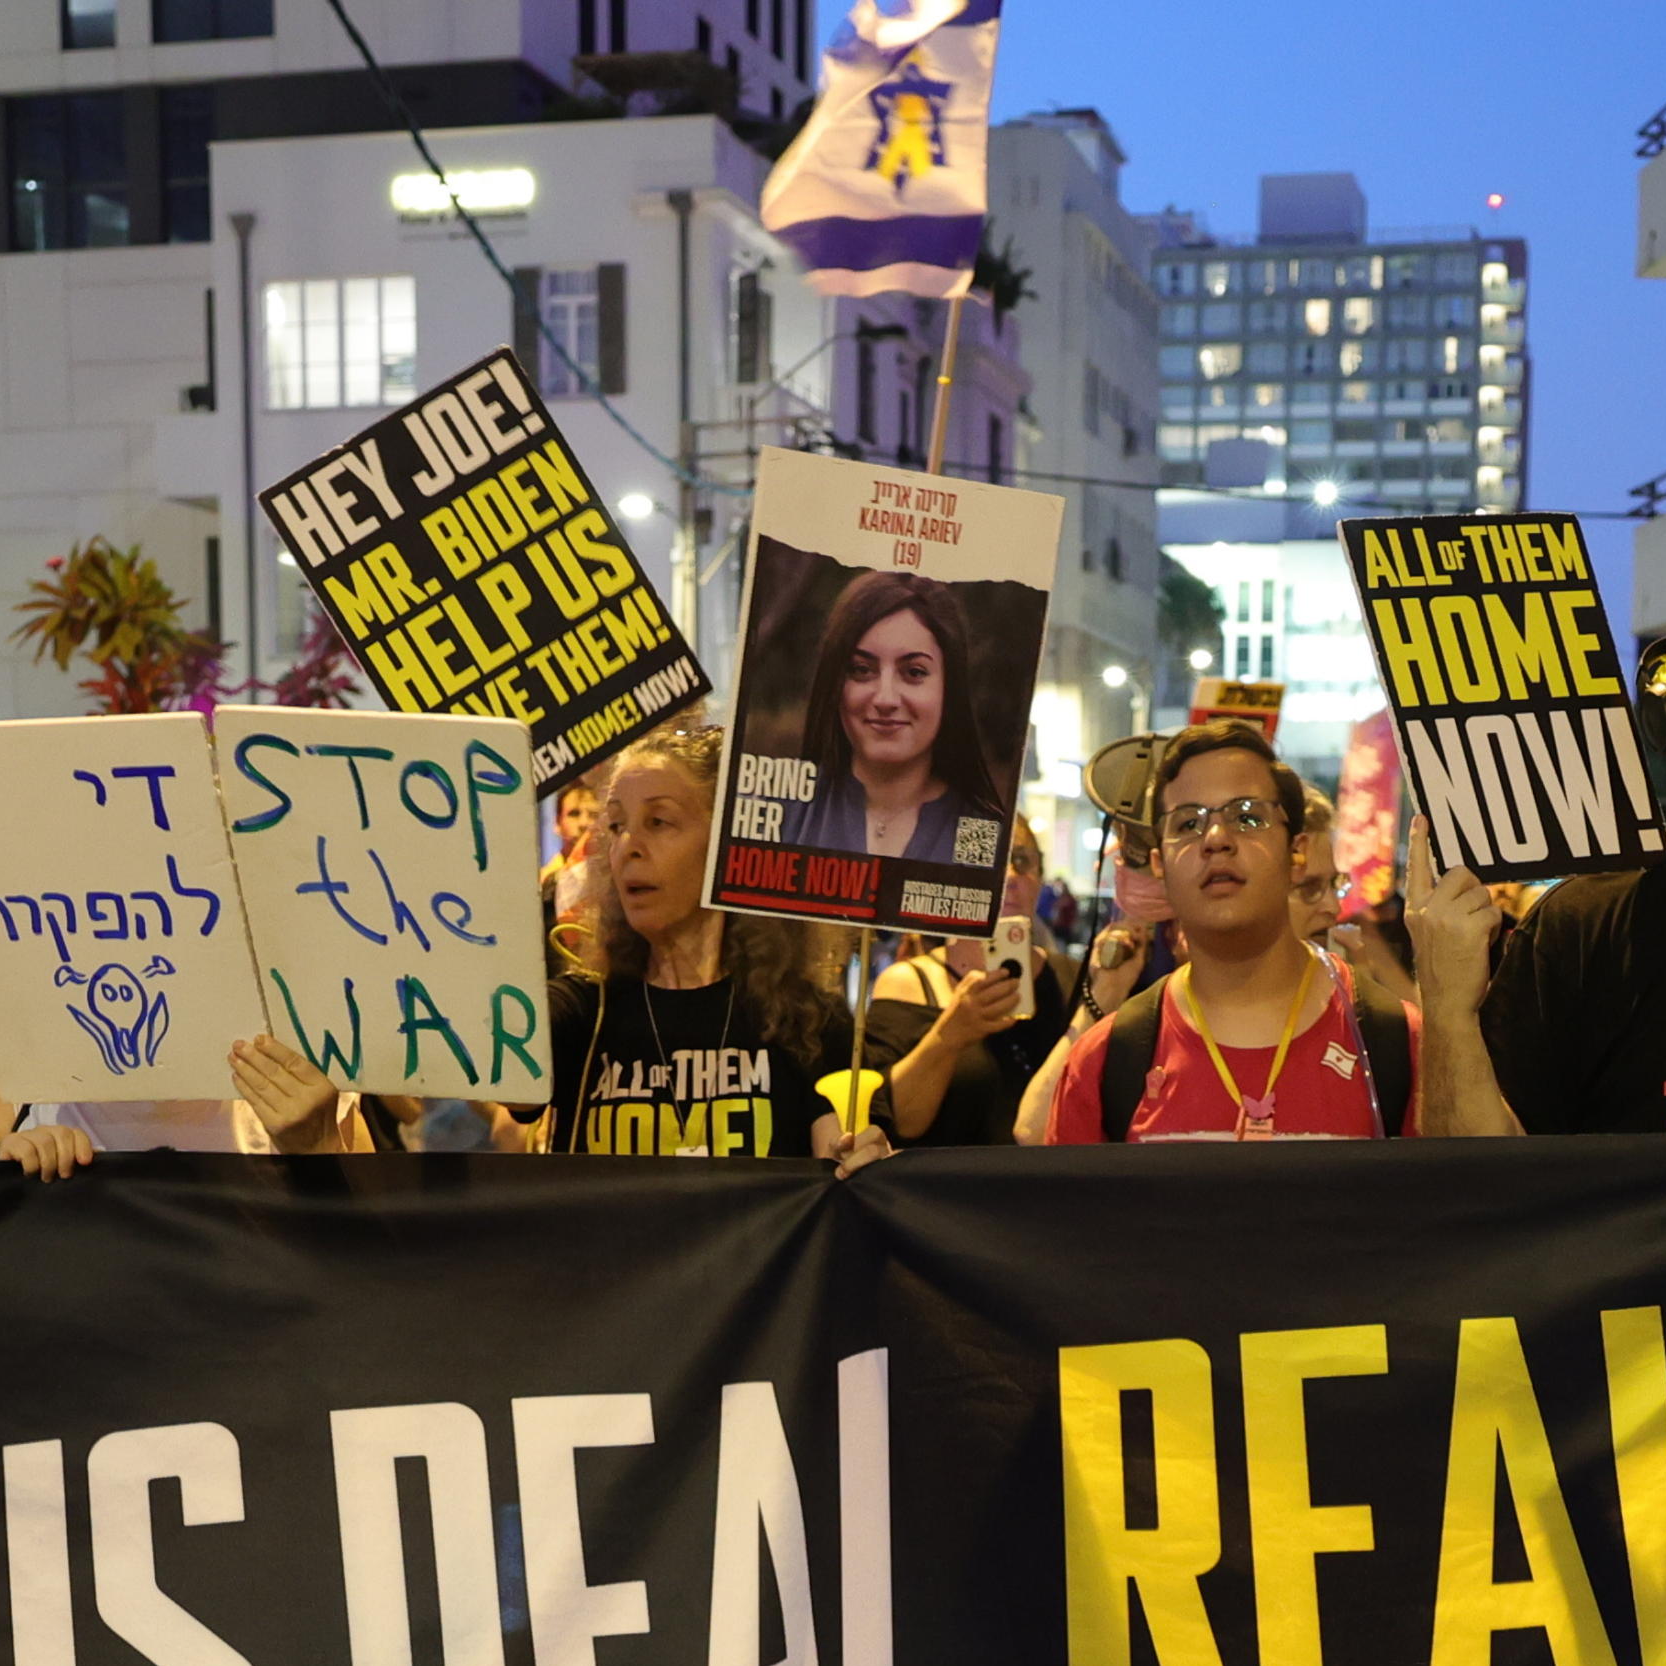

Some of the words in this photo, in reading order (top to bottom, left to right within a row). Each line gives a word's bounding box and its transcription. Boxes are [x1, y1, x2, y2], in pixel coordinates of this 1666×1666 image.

[271, 438, 405, 569] HEY
[401, 357, 547, 498] JOE!
[321, 541, 444, 641] MR.
[420, 439, 591, 580] BIDEN
[858, 507, 915, 538] KARINA
[918, 517, 962, 545] ARIEV
[893, 539, 922, 569] (19)
[1363, 527, 1453, 589] ALL
[1438, 539, 1467, 572] OF
[1460, 523, 1589, 583] THEM
[365, 561, 533, 713] HELP
[524, 507, 636, 621] US
[525, 585, 671, 706] THEM!
[1371, 590, 1621, 709] HOME
[533, 735, 576, 786] HEM
[567, 692, 642, 758] HOME!
[633, 655, 700, 717] NOW!
[737, 753, 817, 803] BRING
[73, 764, 177, 831] די
[233, 732, 522, 872] STOP
[731, 797, 784, 843] HER
[1405, 706, 1665, 870] NOW!
[296, 835, 497, 952] the
[724, 845, 801, 893] HOME
[804, 855, 881, 903] NOW!
[901, 895, 953, 918] FAMILIES
[953, 900, 991, 922] FORUM
[269, 966, 544, 1086] WAR
[590, 1051, 653, 1101] ALL
[649, 1064, 672, 1088] OF
[671, 1047, 771, 1101] THEM
